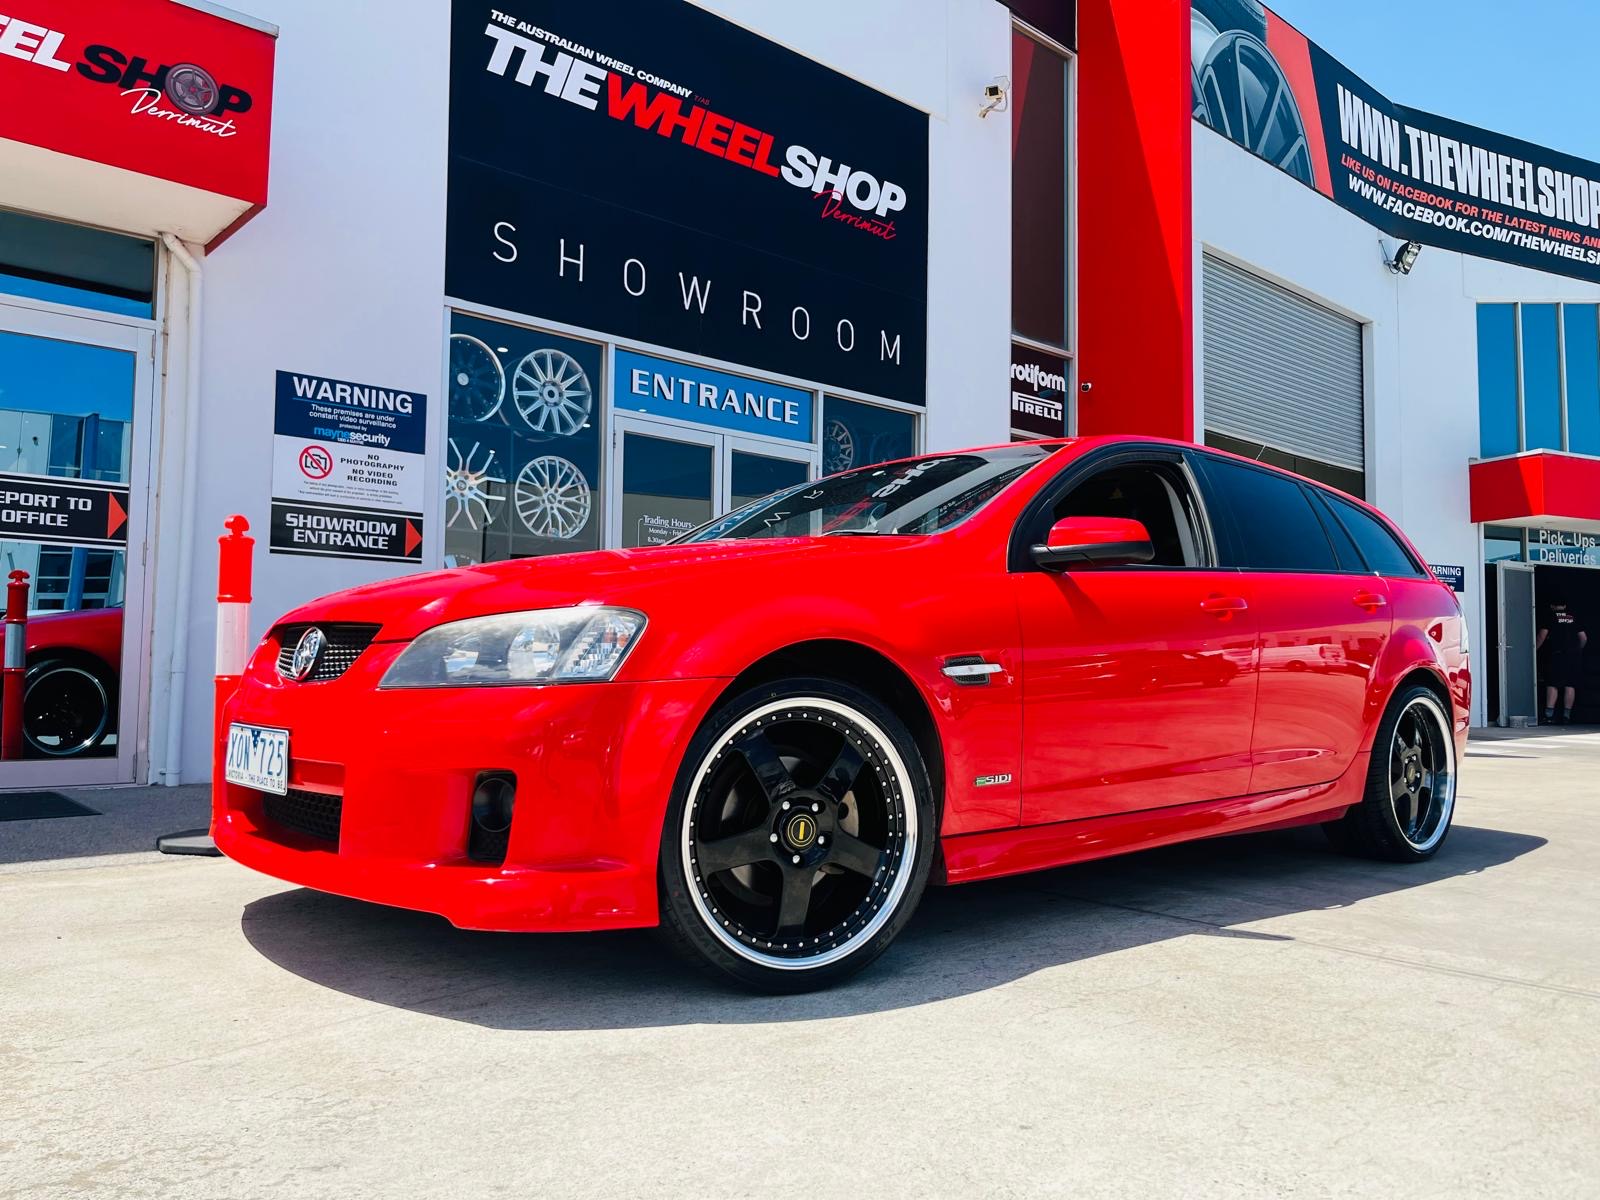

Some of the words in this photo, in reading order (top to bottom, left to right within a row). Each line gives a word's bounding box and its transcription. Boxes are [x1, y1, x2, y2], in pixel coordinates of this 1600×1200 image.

[0, 14, 71, 72] EL
[491, 9, 517, 27] THE
[516, 21, 595, 60] AUSTRALIAN
[595, 52, 635, 77] WHEEL
[636, 70, 693, 98] COMPANY
[120, 88, 237, 137] Derrimut
[1341, 153, 1361, 175] LIKE
[1362, 166, 1375, 182] US
[1376, 174, 1392, 190] ON
[1392, 181, 1454, 211] FACEBOOK
[1455, 198, 1478, 217] FOR
[1482, 208, 1503, 224] THE
[1505, 214, 1546, 235] LATEST
[1548, 227, 1581, 244] NEWS
[813, 190, 897, 240] Derrimut
[492, 221, 901, 366] SHOWROOM
[293, 376, 413, 414] WARNING
[629, 368, 800, 425] ENTRANCE
[1012, 391, 1063, 421] PIRELLI
[309, 411, 338, 420] constant
[340, 415, 357, 423] video
[359, 418, 396, 429] surveillance
[311, 404, 331, 413] These
[334, 408, 363, 418] premises
[376, 414, 395, 422] under
[340, 457, 405, 471] PHOTOGRAPHY
[352, 468, 365, 476] NO
[368, 470, 394, 479] VIDEO
[347, 475, 398, 487] RECORDING
[66, 497, 92, 511] TO
[2, 509, 68, 527] OFFICE
[285, 512, 397, 537] SHOWROOM
[643, 515, 669, 528] Trading
[672, 518, 692, 528] Hours
[293, 528, 389, 550] ENTRANCE
[649, 528, 668, 536] Monday
[1540, 548, 1596, 566] Deliveries
[1430, 566, 1461, 576] ARNING
[260, 738, 284, 777] 725
